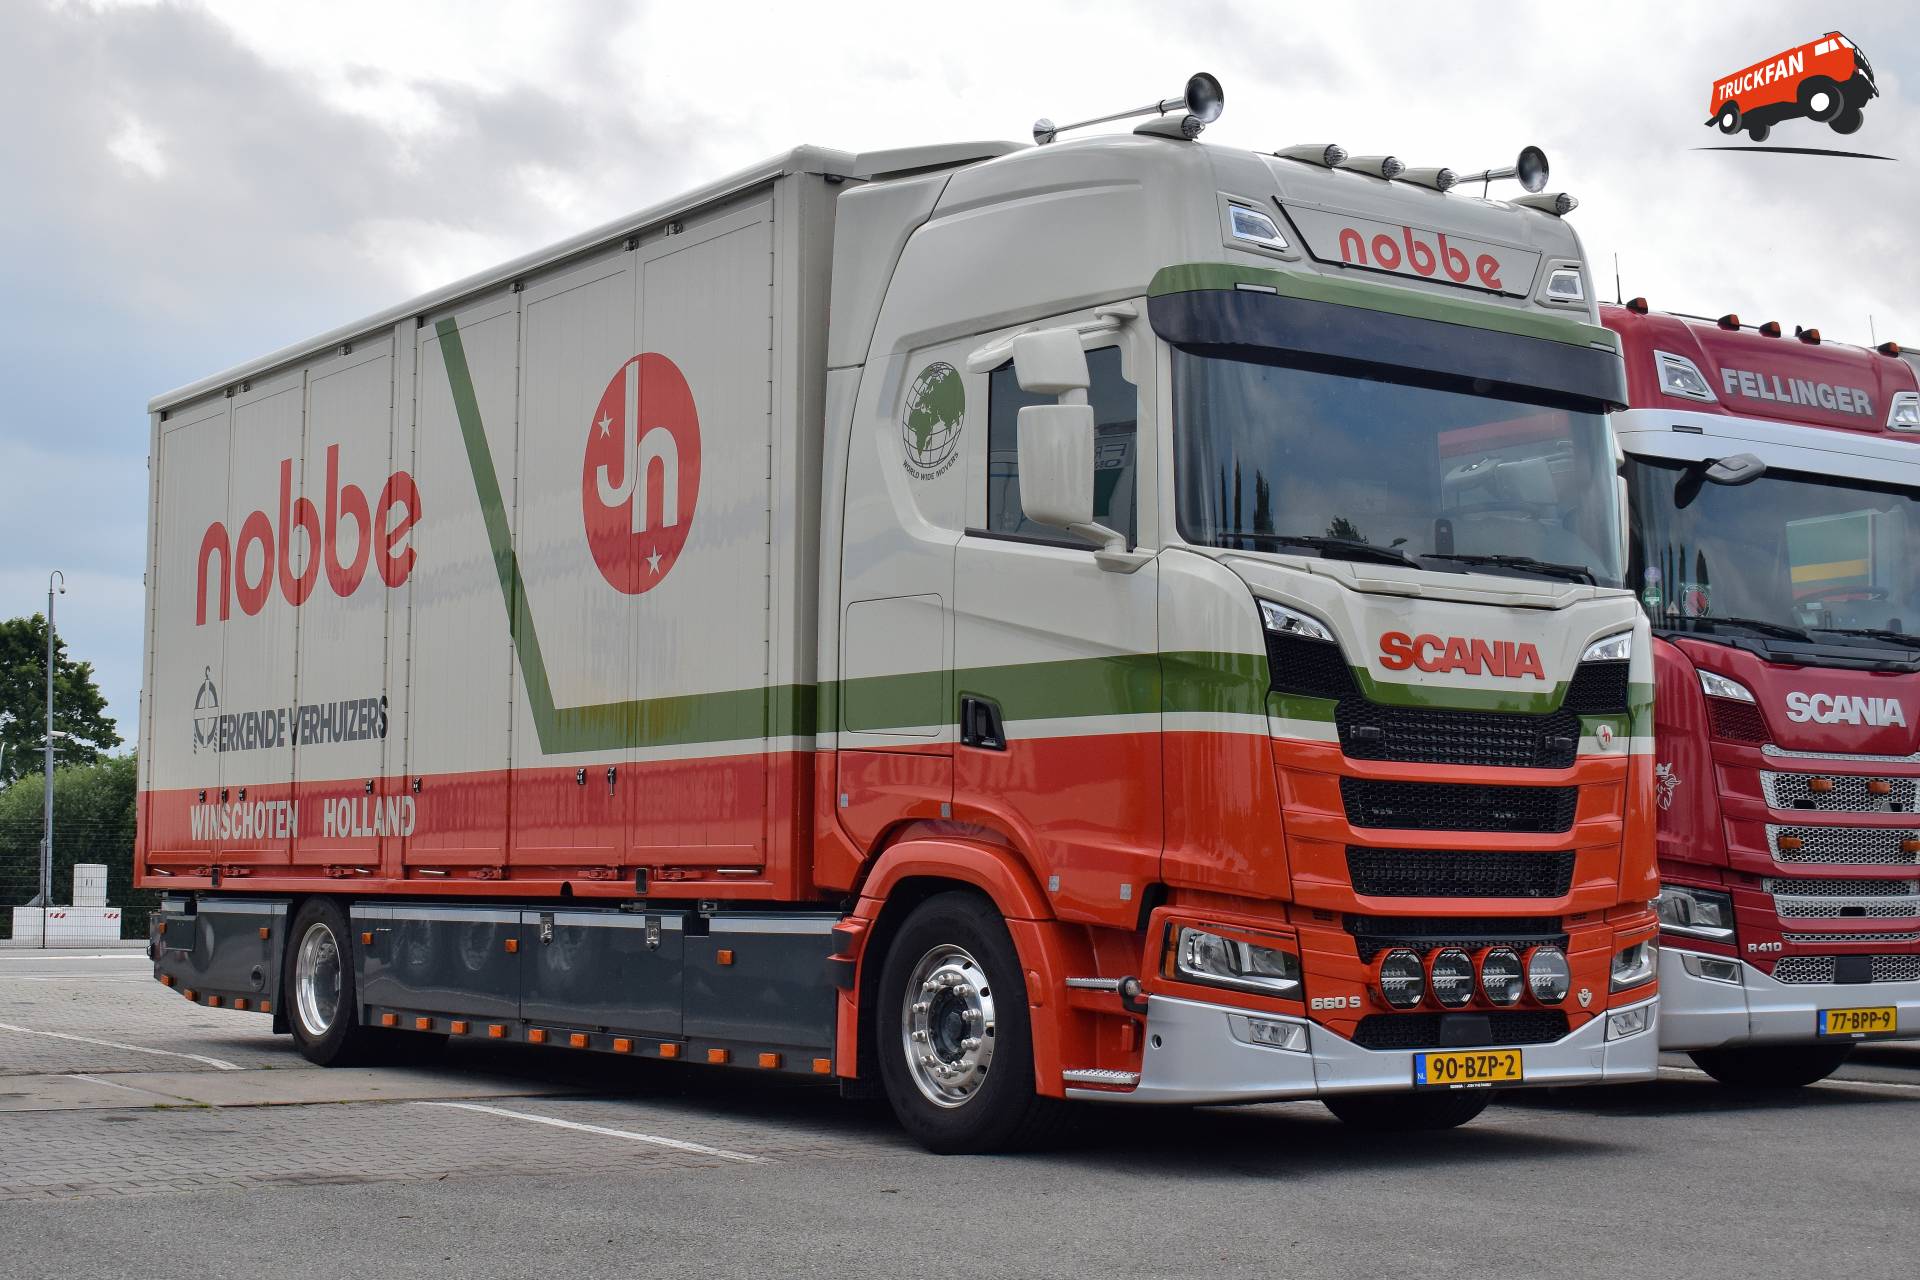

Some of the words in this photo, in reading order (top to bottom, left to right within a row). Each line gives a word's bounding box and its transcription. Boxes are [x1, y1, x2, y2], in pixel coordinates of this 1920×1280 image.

[1338, 226, 1503, 289] nobbe
[1720, 367, 1873, 416] FELLINGER
[902, 459, 920, 479] WORLD
[920, 472, 935, 481] WIDE
[935, 452, 959, 477] MOVERS
[195, 444, 422, 626] nobbe
[1378, 631, 1546, 680] SCANIA
[219, 708, 286, 753] ERKENDE
[288, 695, 388, 746] VERHUIZERS
[1785, 691, 1907, 728] SCANIA
[190, 800, 299, 841] WINSCHOTEN
[323, 795, 416, 838] HOLLAND
[1747, 943, 1758, 953] R
[1758, 942, 1782, 952] 410
[1311, 997, 1347, 1010] 660
[1349, 996, 1361, 1008] S
[1831, 1011, 1891, 1030] 77-BPP-9
[1417, 1072, 1426, 1080] NL
[1433, 1054, 1516, 1080] 90-BZP-2
